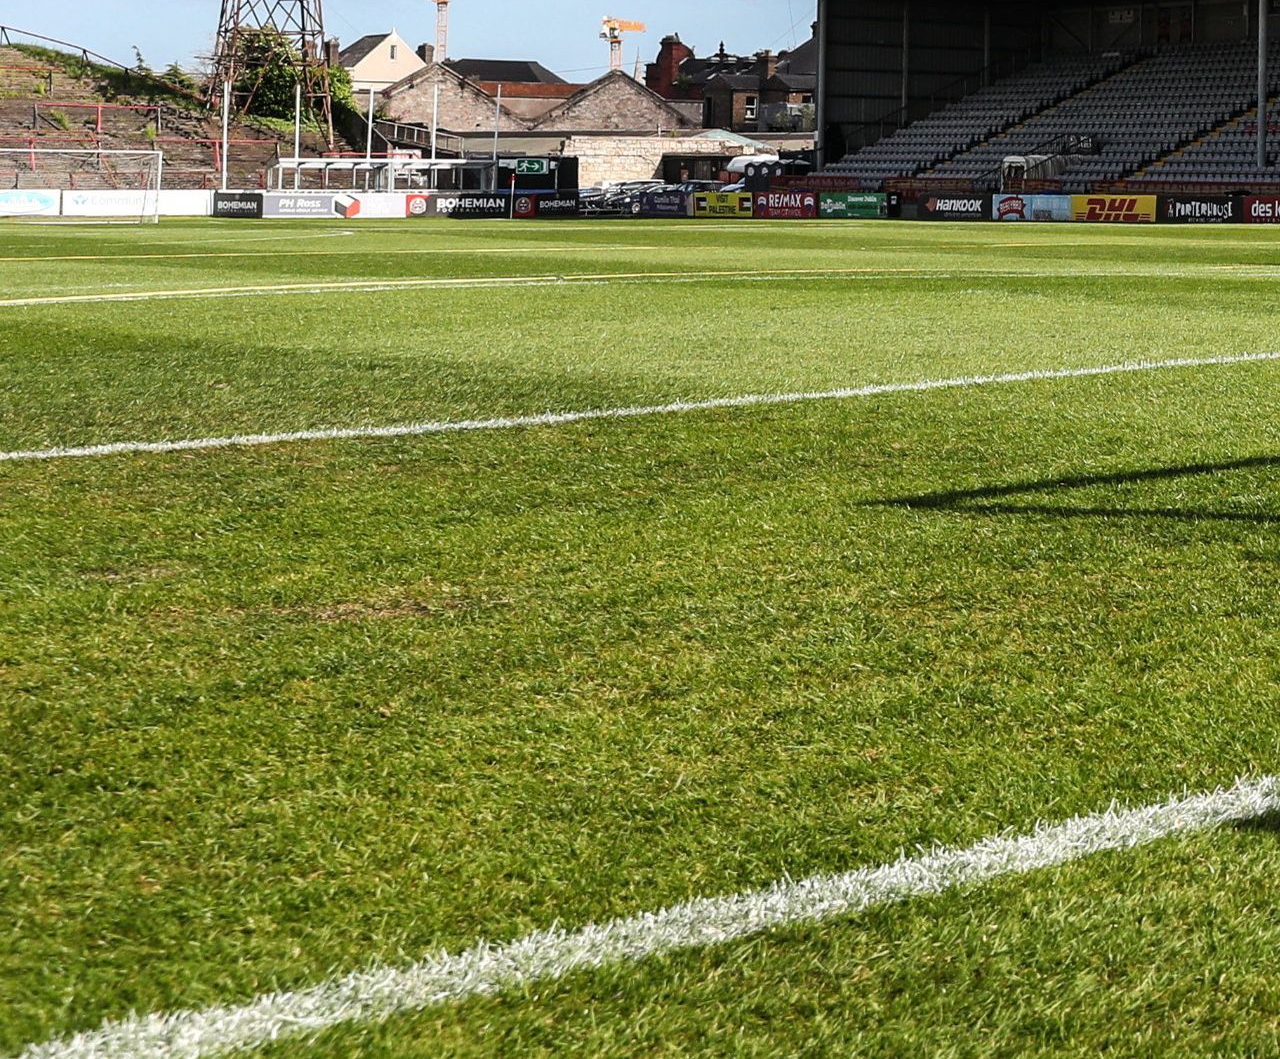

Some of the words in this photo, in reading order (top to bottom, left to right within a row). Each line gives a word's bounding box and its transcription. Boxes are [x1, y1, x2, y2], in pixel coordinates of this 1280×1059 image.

[278, 198, 295, 208] PH
[296, 198, 321, 208] Ross
[436, 197, 505, 208] BOHEMIAN
[539, 199, 576, 209] BOHEMIAN
[716, 194, 728, 204] VISIT
[768, 193, 802, 208] RE/MAX
[217, 201, 257, 209] BOHEMIAN
[708, 205, 736, 215] PALESTINE
[1086, 198, 1140, 221] DHL
[1175, 201, 1233, 219] PORTERHOUSE
[1251, 200, 1273, 217] des
